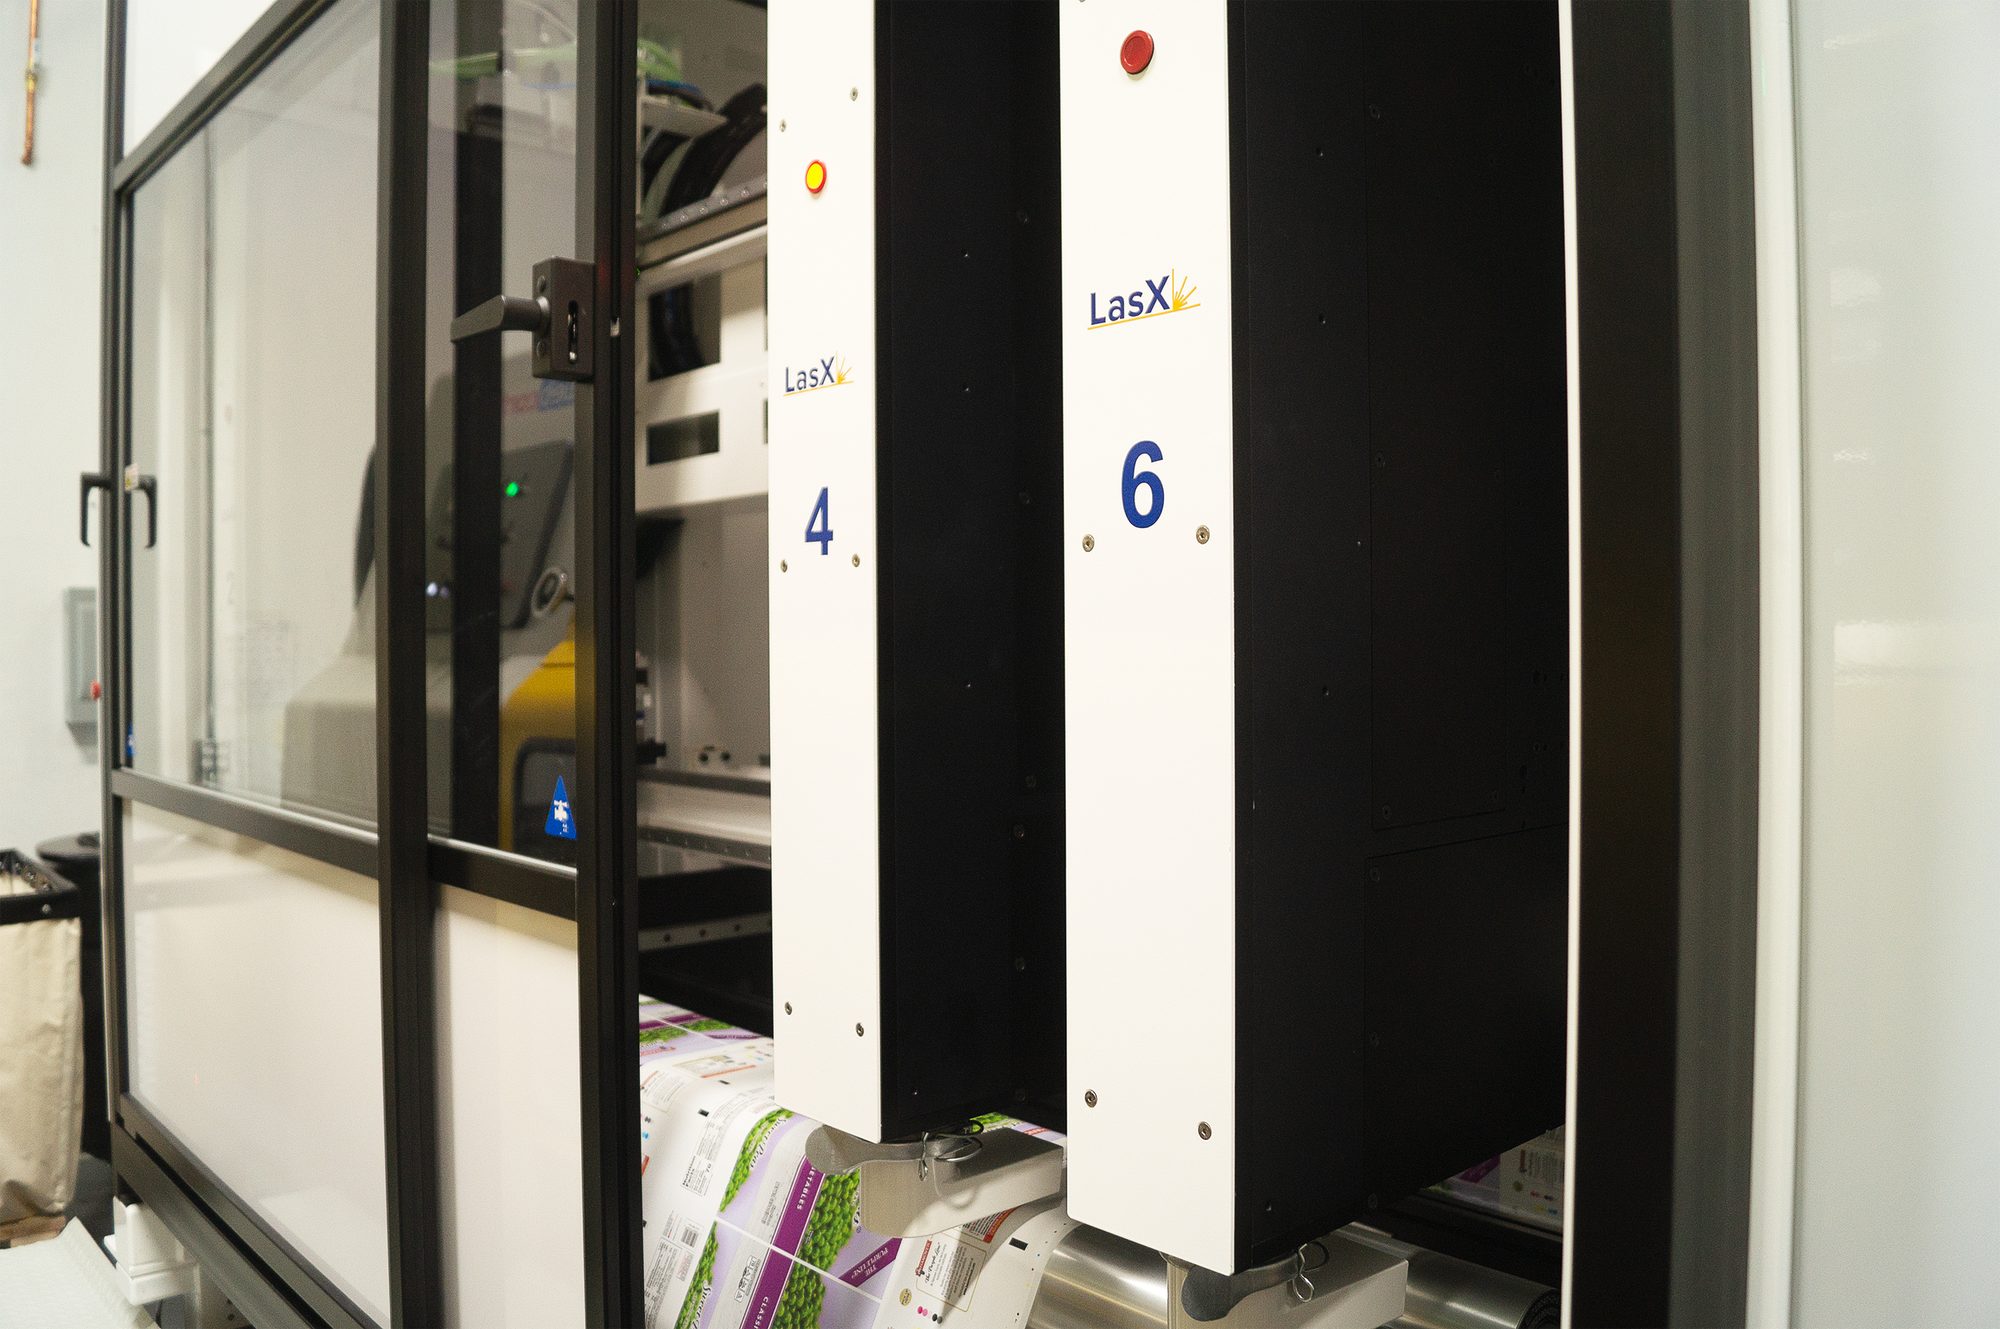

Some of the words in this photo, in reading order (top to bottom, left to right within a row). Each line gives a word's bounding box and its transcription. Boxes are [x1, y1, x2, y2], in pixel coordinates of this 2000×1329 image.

[1090, 275, 1170, 326] LasX
[785, 356, 835, 393] LasX
[1121, 440, 1165, 529] 6
[804, 486, 834, 556] 4
